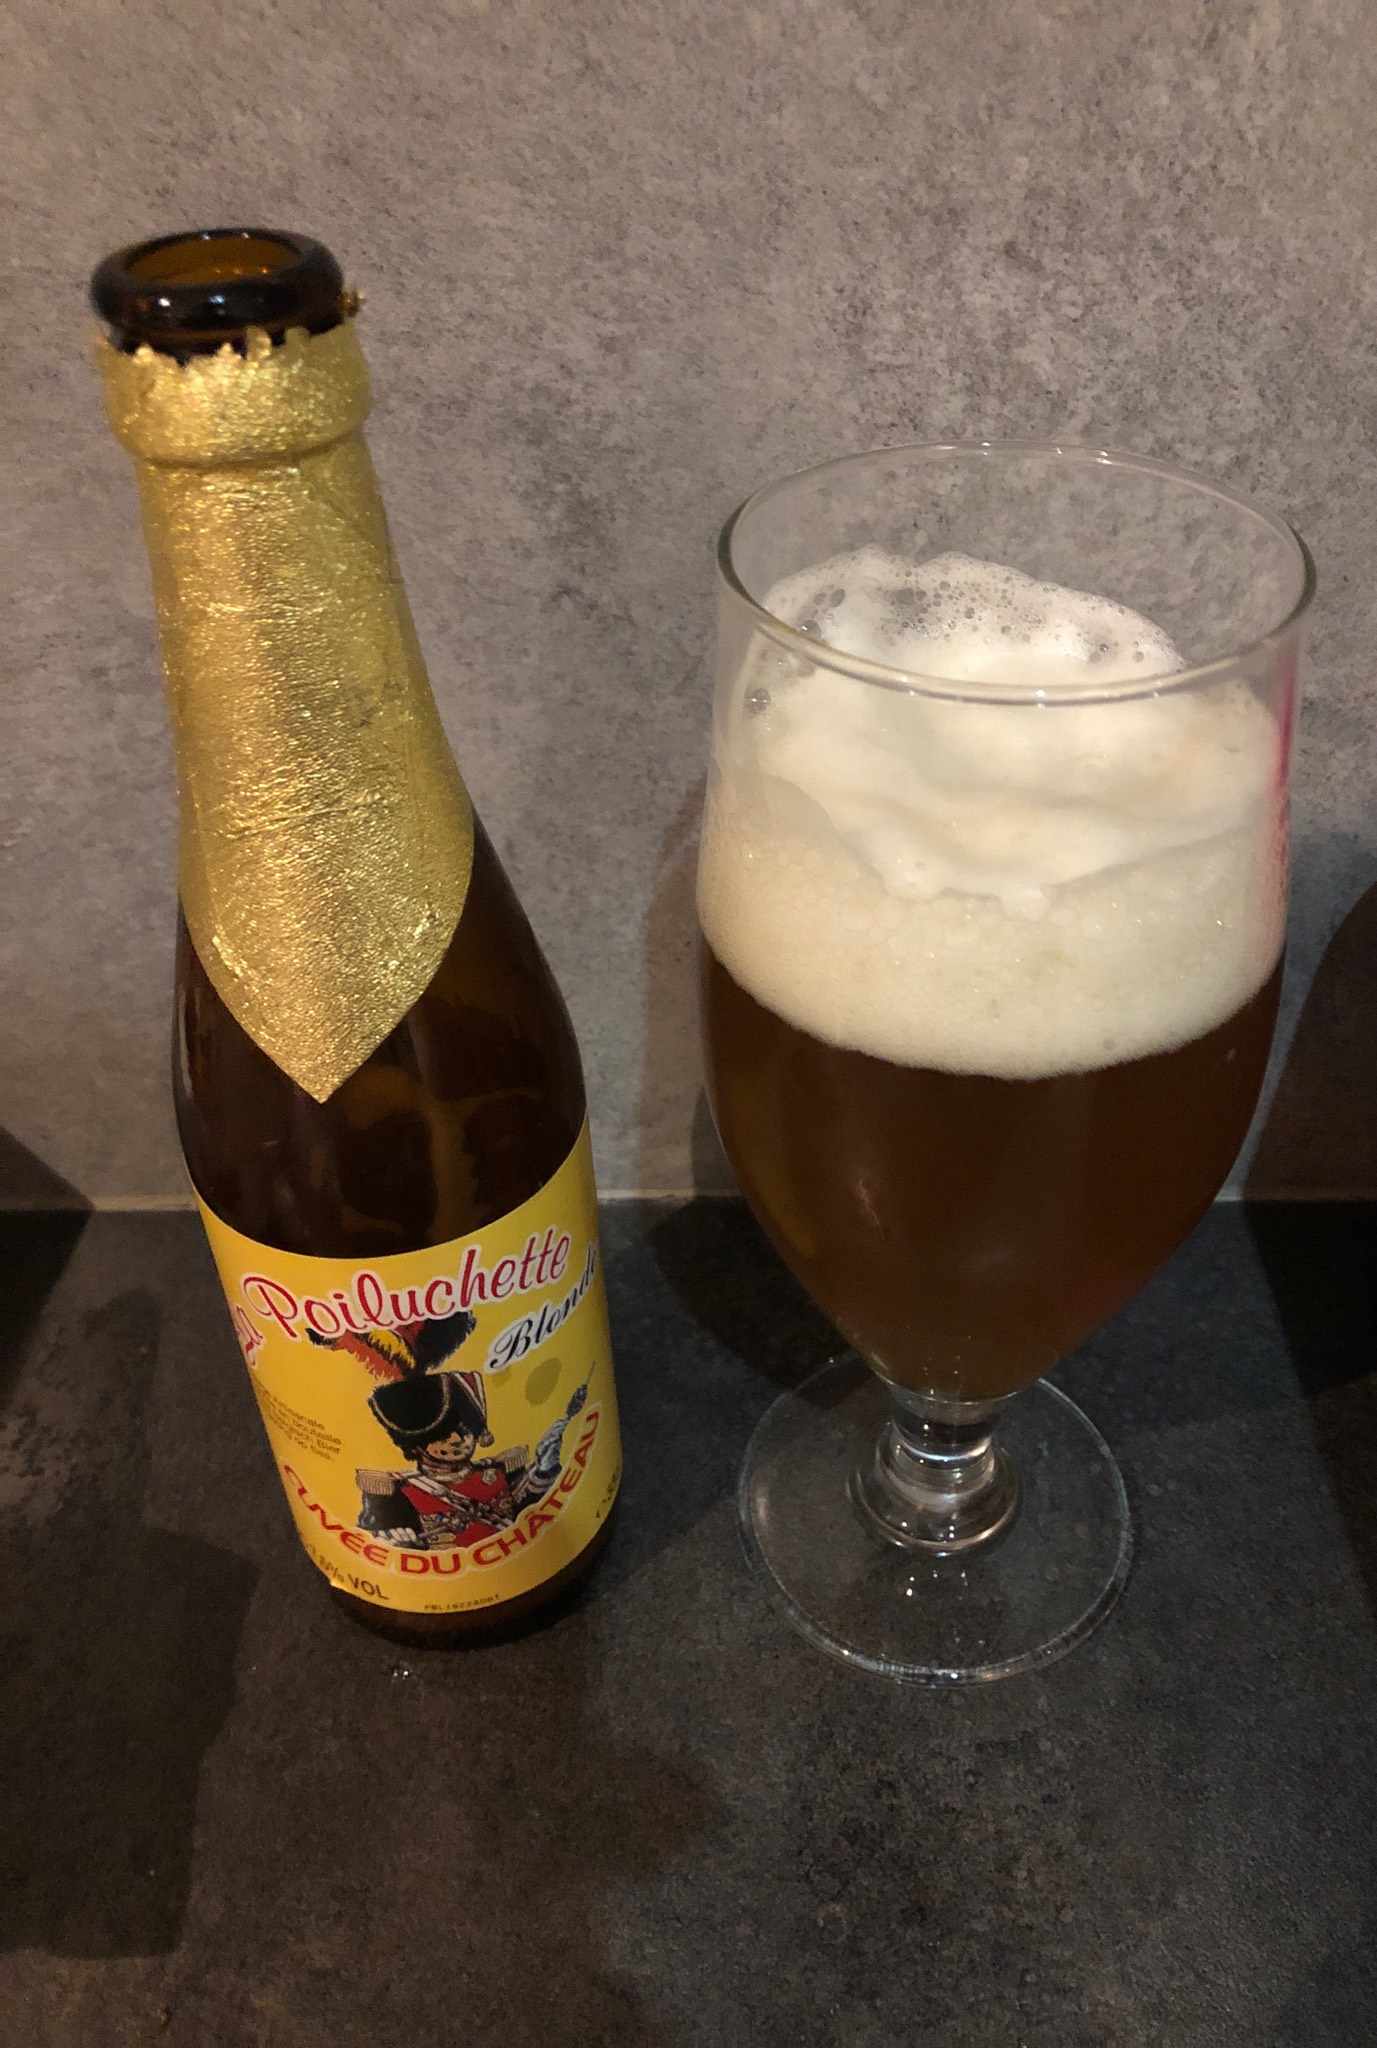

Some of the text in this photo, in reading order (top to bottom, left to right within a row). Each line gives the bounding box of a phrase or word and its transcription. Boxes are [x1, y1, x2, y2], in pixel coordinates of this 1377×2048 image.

[244, 1228, 570, 1338] Poiluchette
[283, 1464, 389, 1567] CUVÉE
[400, 1553, 461, 1575] DU
[472, 1410, 599, 1566] CHÂTEAU
[347, 1573, 390, 1600] VOL
